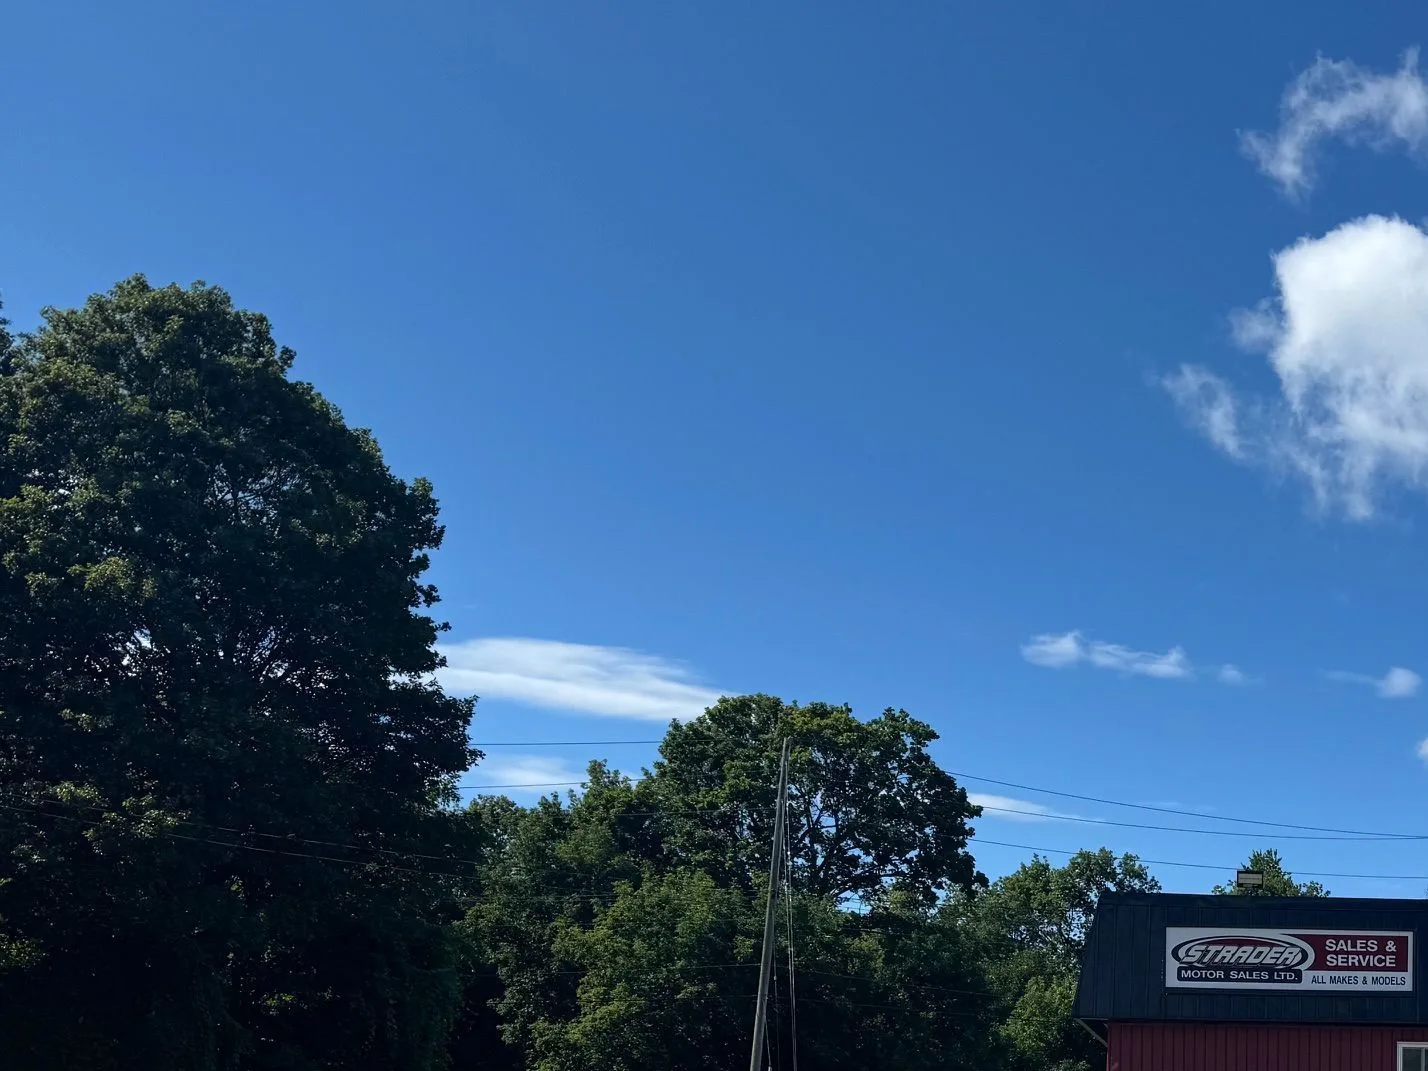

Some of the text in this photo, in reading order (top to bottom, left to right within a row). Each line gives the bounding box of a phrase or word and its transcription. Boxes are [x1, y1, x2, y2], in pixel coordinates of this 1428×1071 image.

[1325, 939, 1397, 952] SALES &
[1181, 944, 1300, 965] STRADER
[1326, 954, 1396, 967] SERVICE
[1181, 969, 1298, 981] MOTOR SALES LTD.
[1311, 975, 1406, 986] ALL MAKES & MODELS
